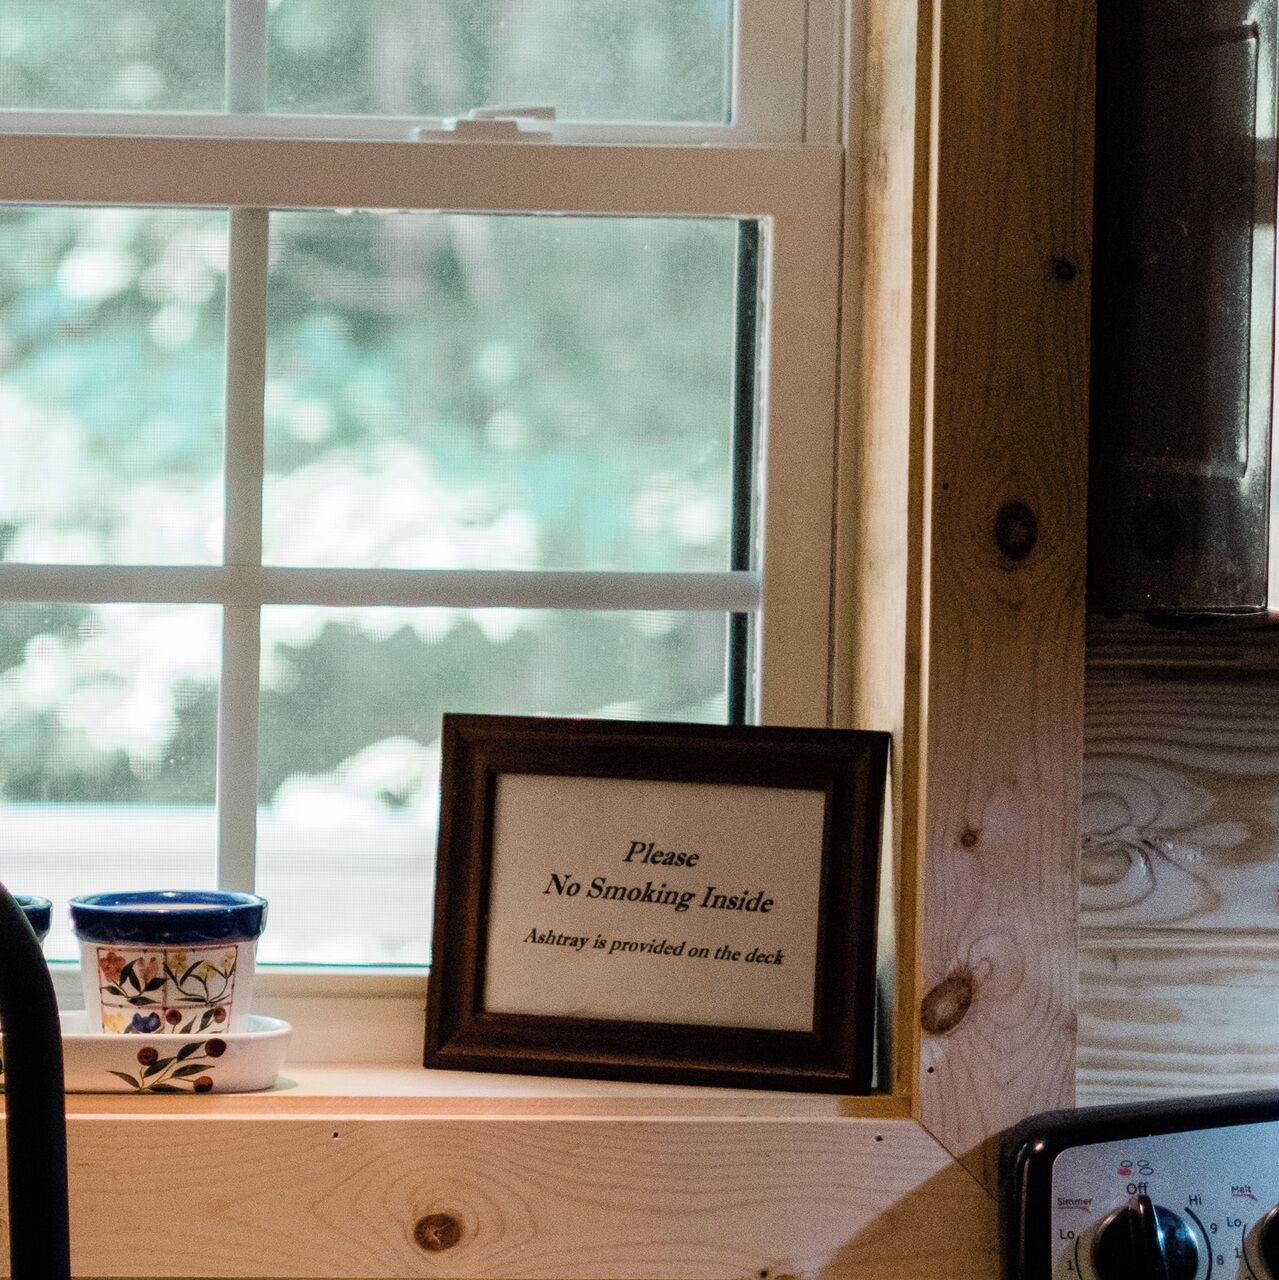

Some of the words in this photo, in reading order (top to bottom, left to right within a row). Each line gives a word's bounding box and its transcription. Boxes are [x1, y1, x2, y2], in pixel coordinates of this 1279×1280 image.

[621, 840, 700, 869] Please
[542, 873, 581, 899] No
[585, 876, 696, 912] Smoking
[700, 886, 775, 914] Inside
[523, 927, 589, 951] Ashtray
[593, 932, 607, 950] is
[608, 937, 685, 958] provided
[688, 945, 710, 958] on
[714, 945, 741, 962] the
[744, 948, 785, 966] deck
[1126, 1182, 1148, 1195] Off
[1057, 1196, 1093, 1207] Simmer
[1189, 1194, 1202, 1207] Hi
[1210, 1223, 1218, 1234] 9
[1226, 1217, 1241, 1228] Lo
[1059, 1228, 1075, 1240] Lo
[1216, 1254, 1224, 1266] 8
